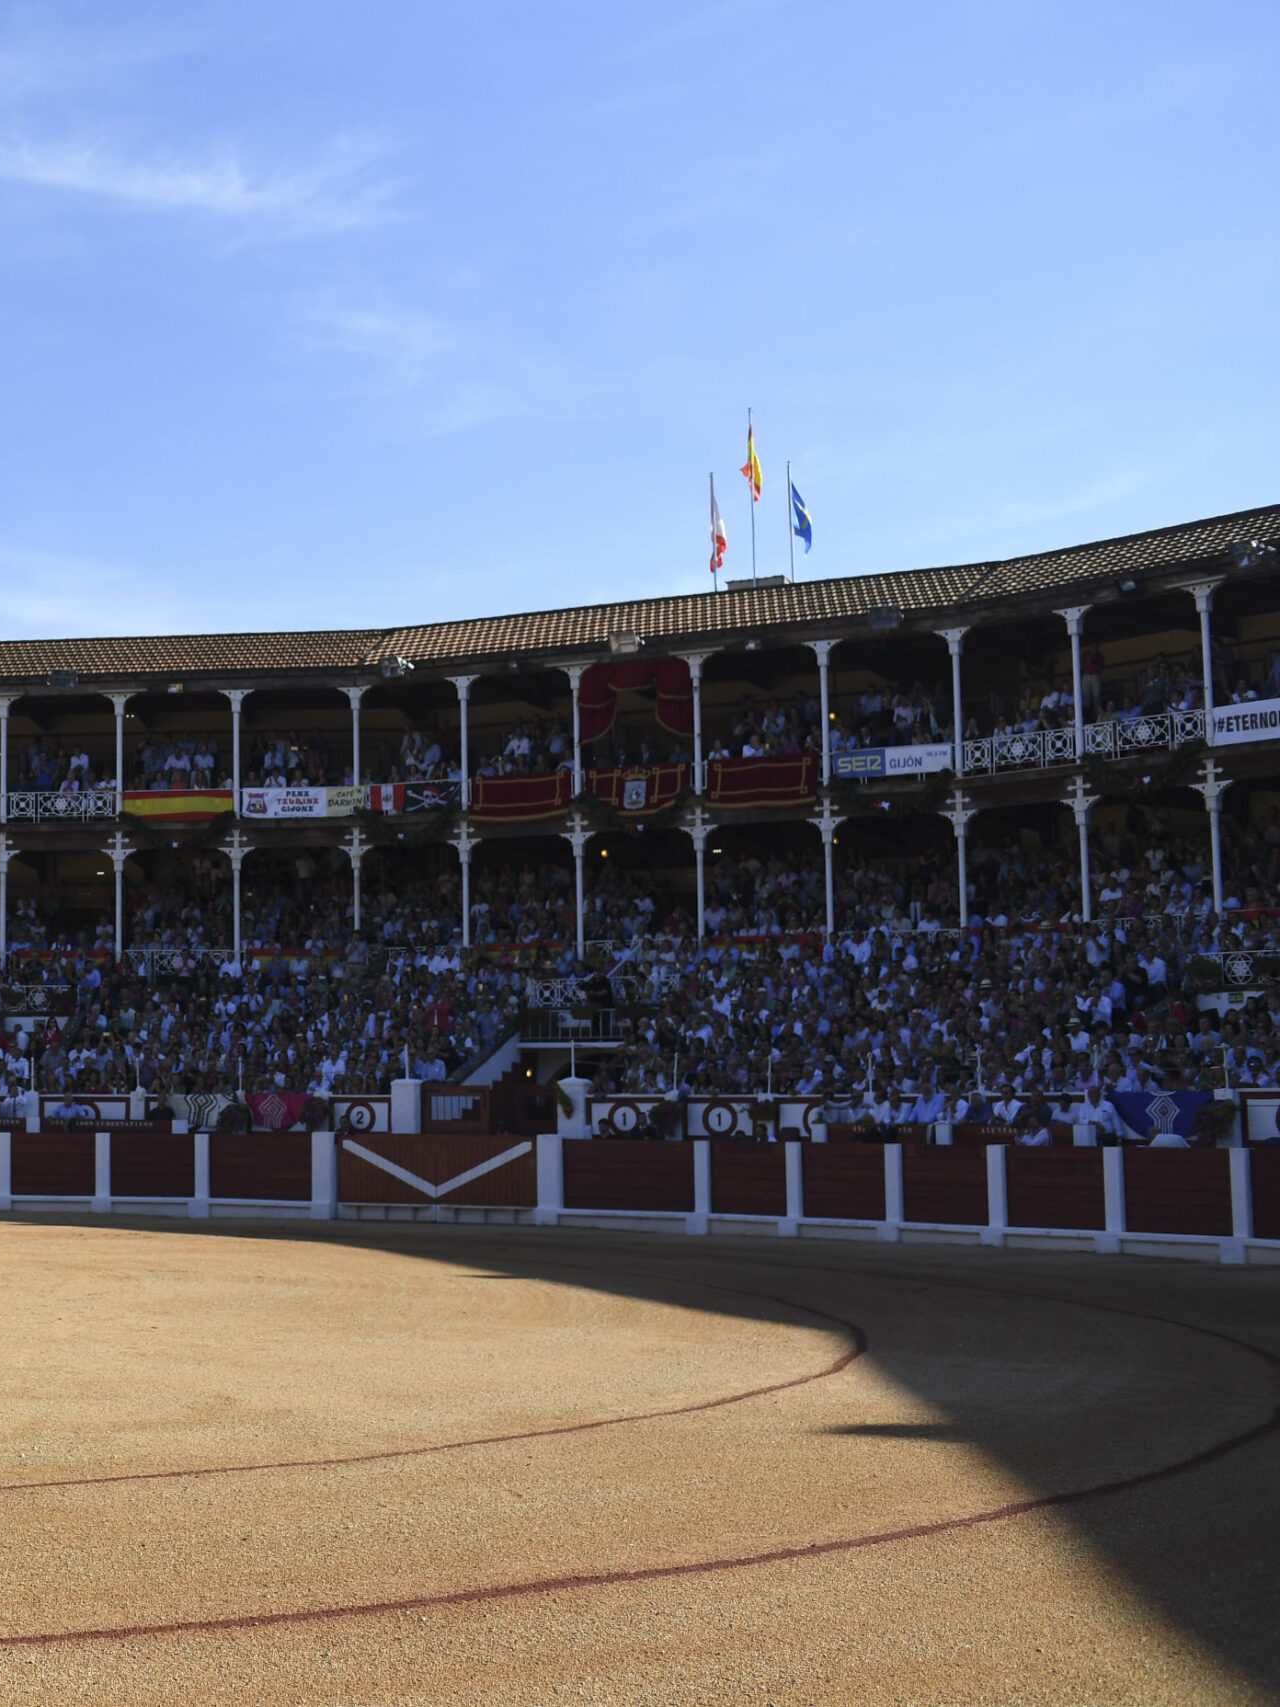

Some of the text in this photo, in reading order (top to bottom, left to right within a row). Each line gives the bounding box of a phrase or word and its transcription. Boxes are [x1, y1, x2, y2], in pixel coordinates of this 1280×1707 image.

[1217, 710, 1280, 733] #ETERNO
[837, 755, 923, 773] SER GIJÓN
[356, 1111, 365, 1124] 2
[621, 1112, 627, 1127] 1
[717, 1112, 723, 1127] 1
